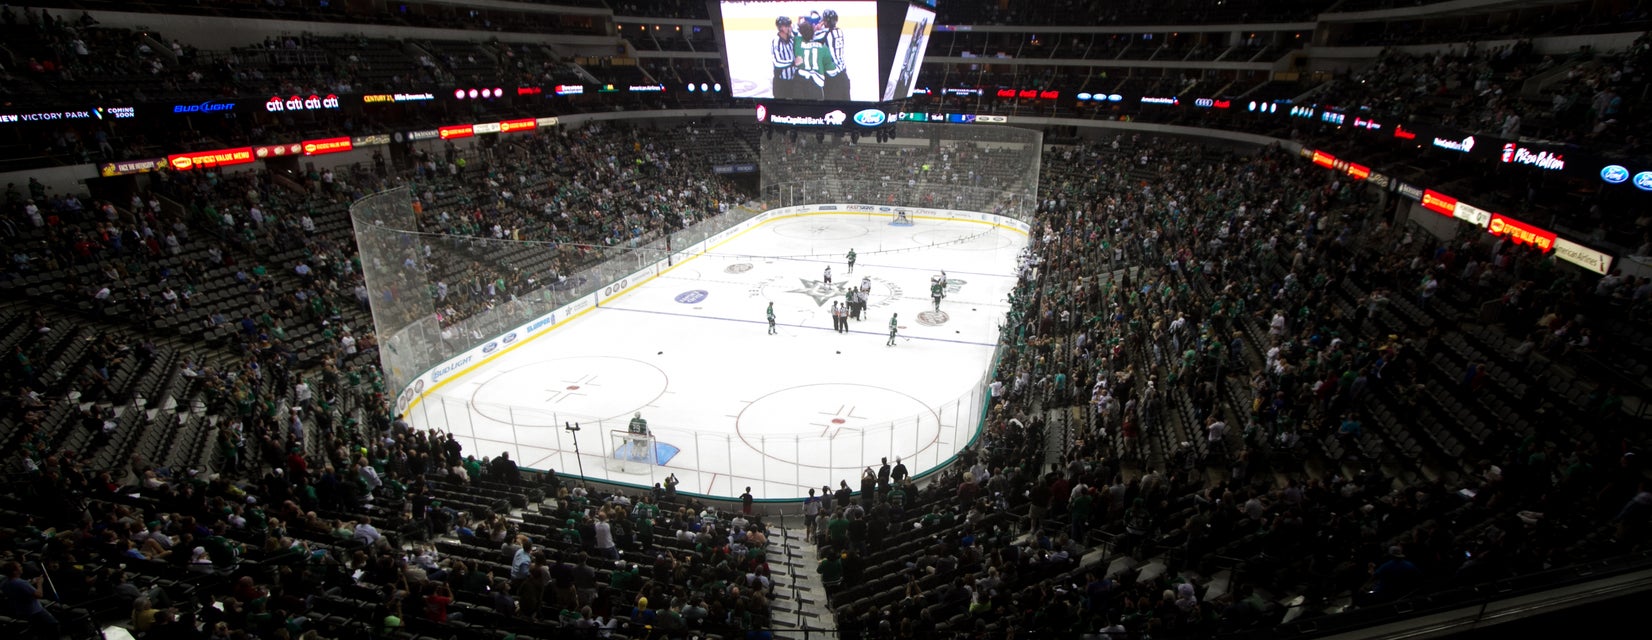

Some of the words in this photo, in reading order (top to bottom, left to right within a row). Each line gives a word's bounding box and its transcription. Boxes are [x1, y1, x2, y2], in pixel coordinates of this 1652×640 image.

[804, 48, 819, 70] 11
[266, 97, 284, 111] citi
[286, 96, 303, 110] citi
[305, 95, 321, 110] citi
[323, 94, 339, 108] citi
[21, 112, 62, 121] VICTORY
[215, 153, 233, 161] VALUE
[234, 151, 249, 159] MENU
[1513, 147, 1536, 165] Pizza
